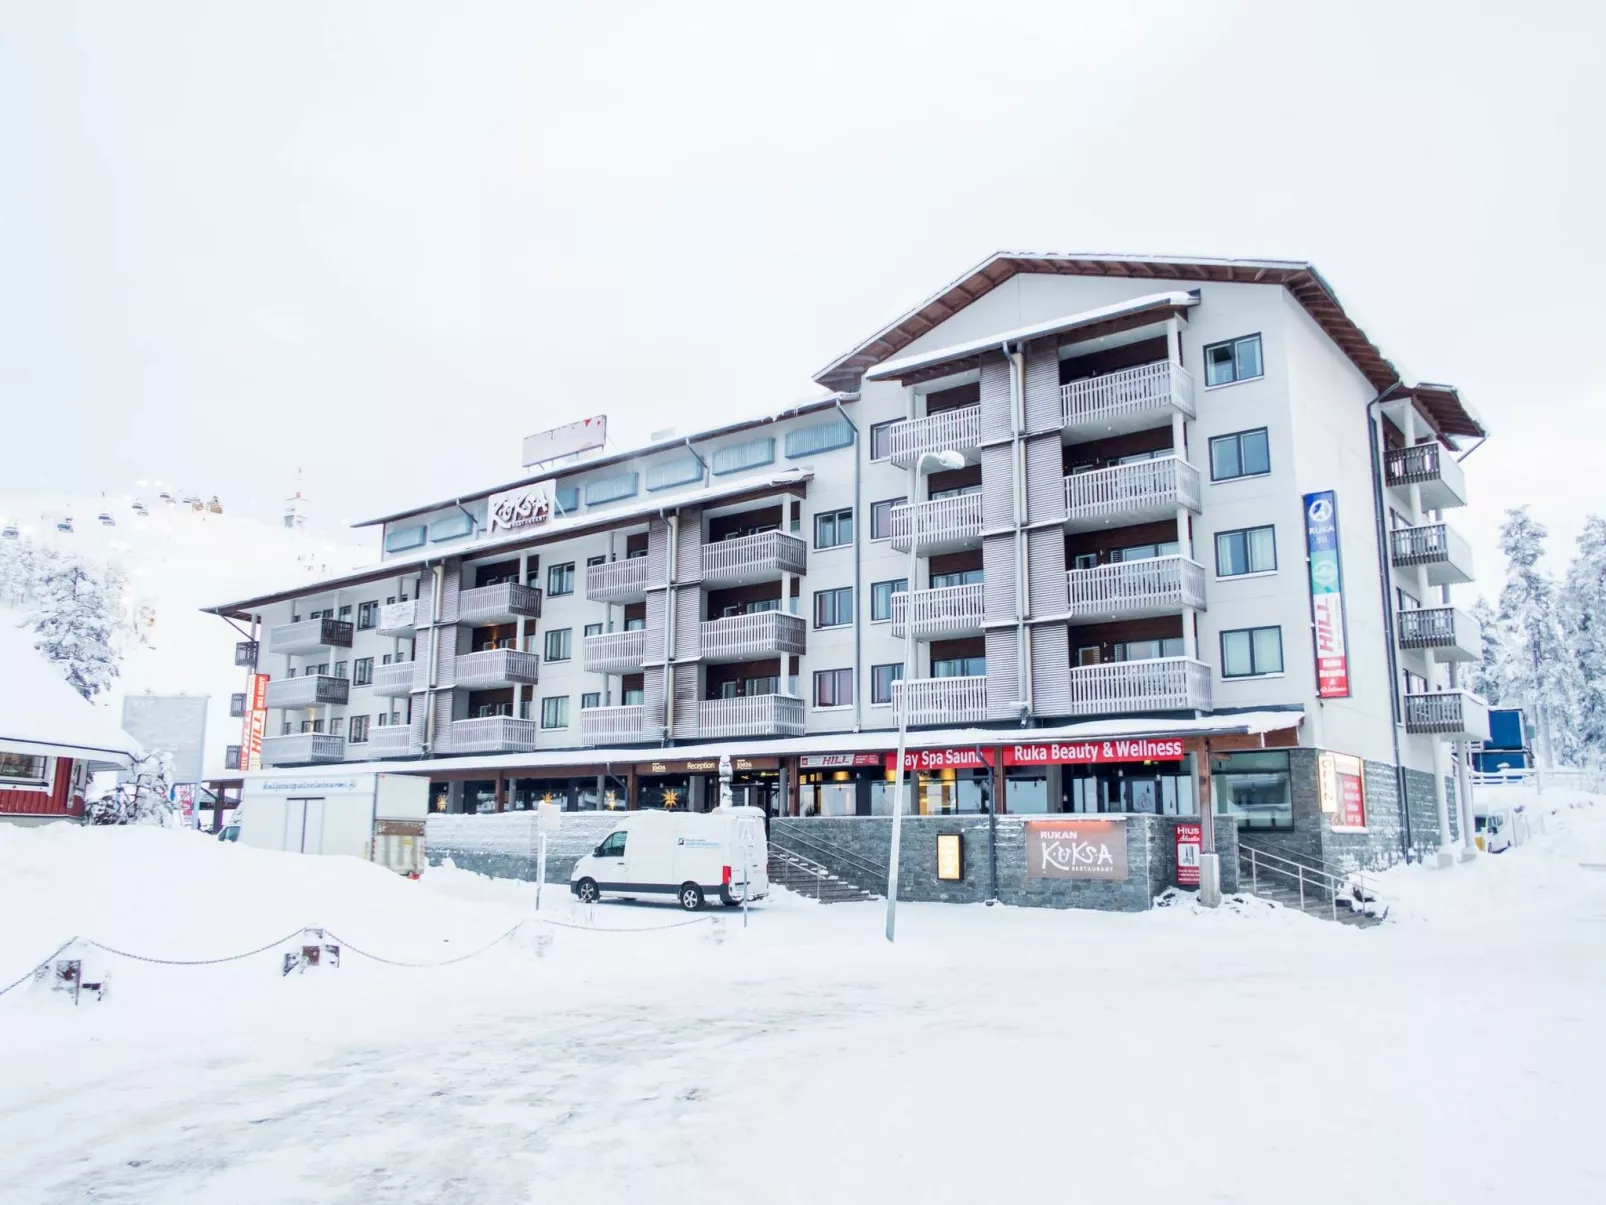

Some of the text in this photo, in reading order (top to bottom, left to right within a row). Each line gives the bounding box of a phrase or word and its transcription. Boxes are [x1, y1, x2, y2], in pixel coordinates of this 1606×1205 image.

[490, 489, 549, 533] KUKSA
[1316, 597, 1334, 652] HILL
[251, 714, 262, 754] HILL
[822, 755, 850, 765] HILL
[922, 750, 944, 769] Spa
[1014, 740, 1182, 762] Ruka Beauty & Wellness
[687, 762, 715, 771] Reception
[1040, 831, 1077, 839] RUKAN
[1041, 841, 1113, 871] KUKSA
